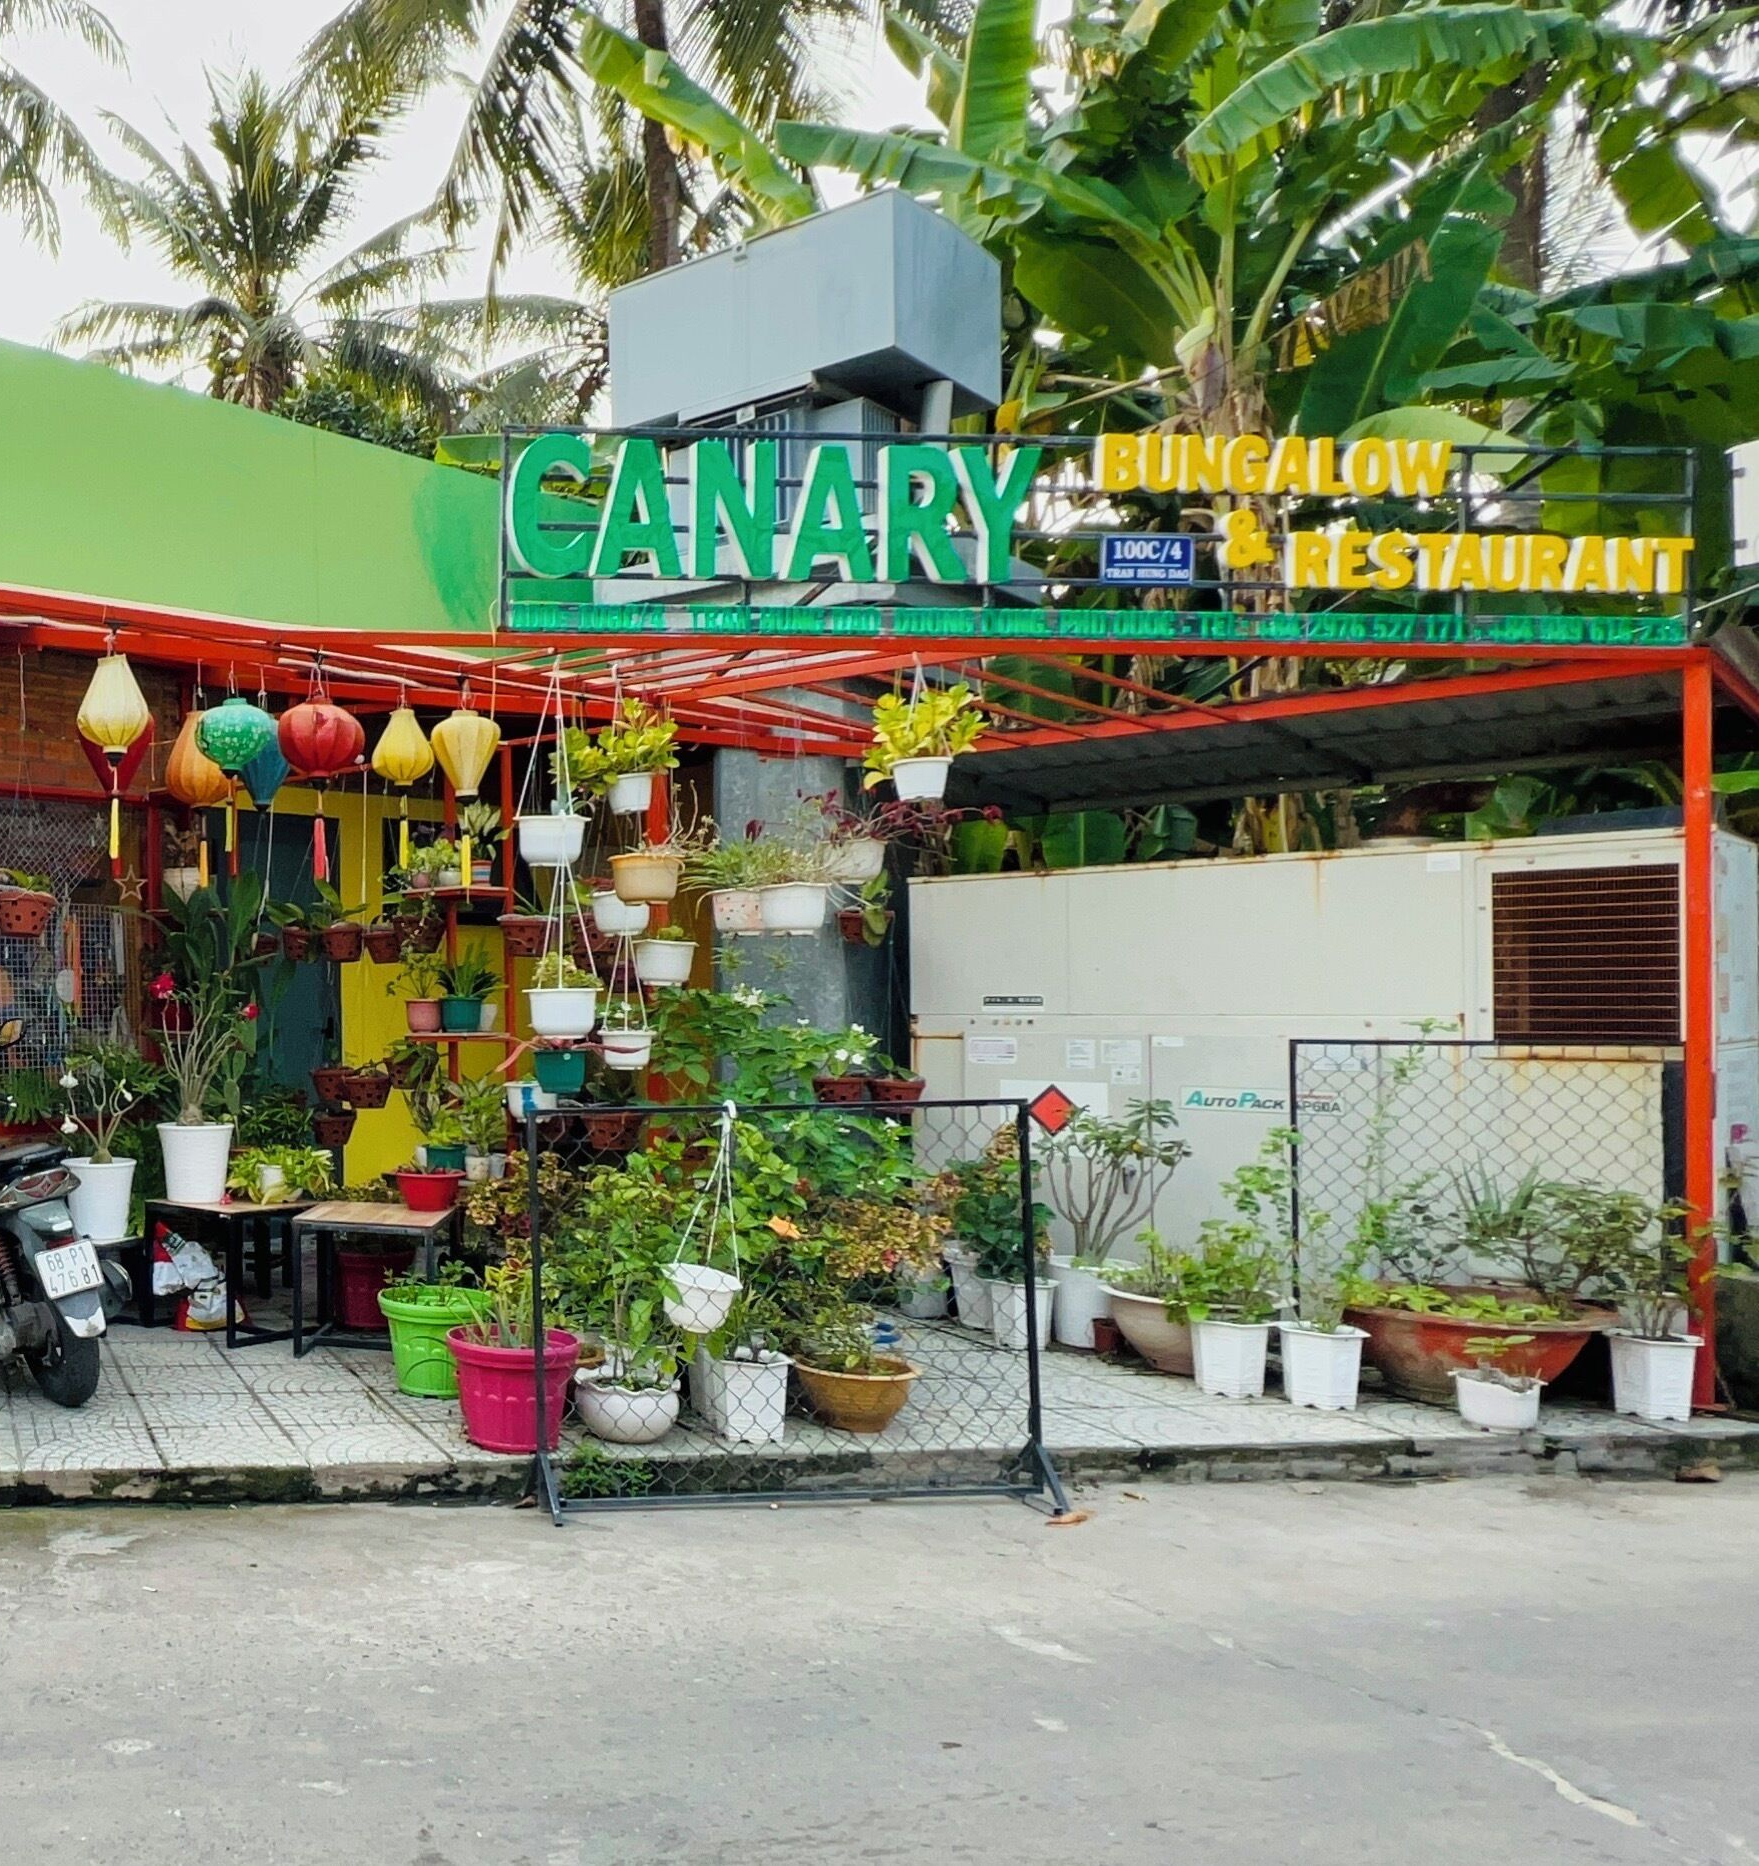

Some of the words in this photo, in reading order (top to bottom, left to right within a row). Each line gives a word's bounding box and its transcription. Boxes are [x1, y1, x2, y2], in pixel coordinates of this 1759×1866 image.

[1094, 433, 1453, 496] BUNGALOW
[511, 433, 1044, 585] CANARY
[1105, 568, 1135, 579] TRAN
[1113, 540, 1183, 563] 100C/4
[1218, 508, 1275, 569] &
[1286, 530, 1695, 594] RESTAURANT
[1373, 614, 1420, 643] 527
